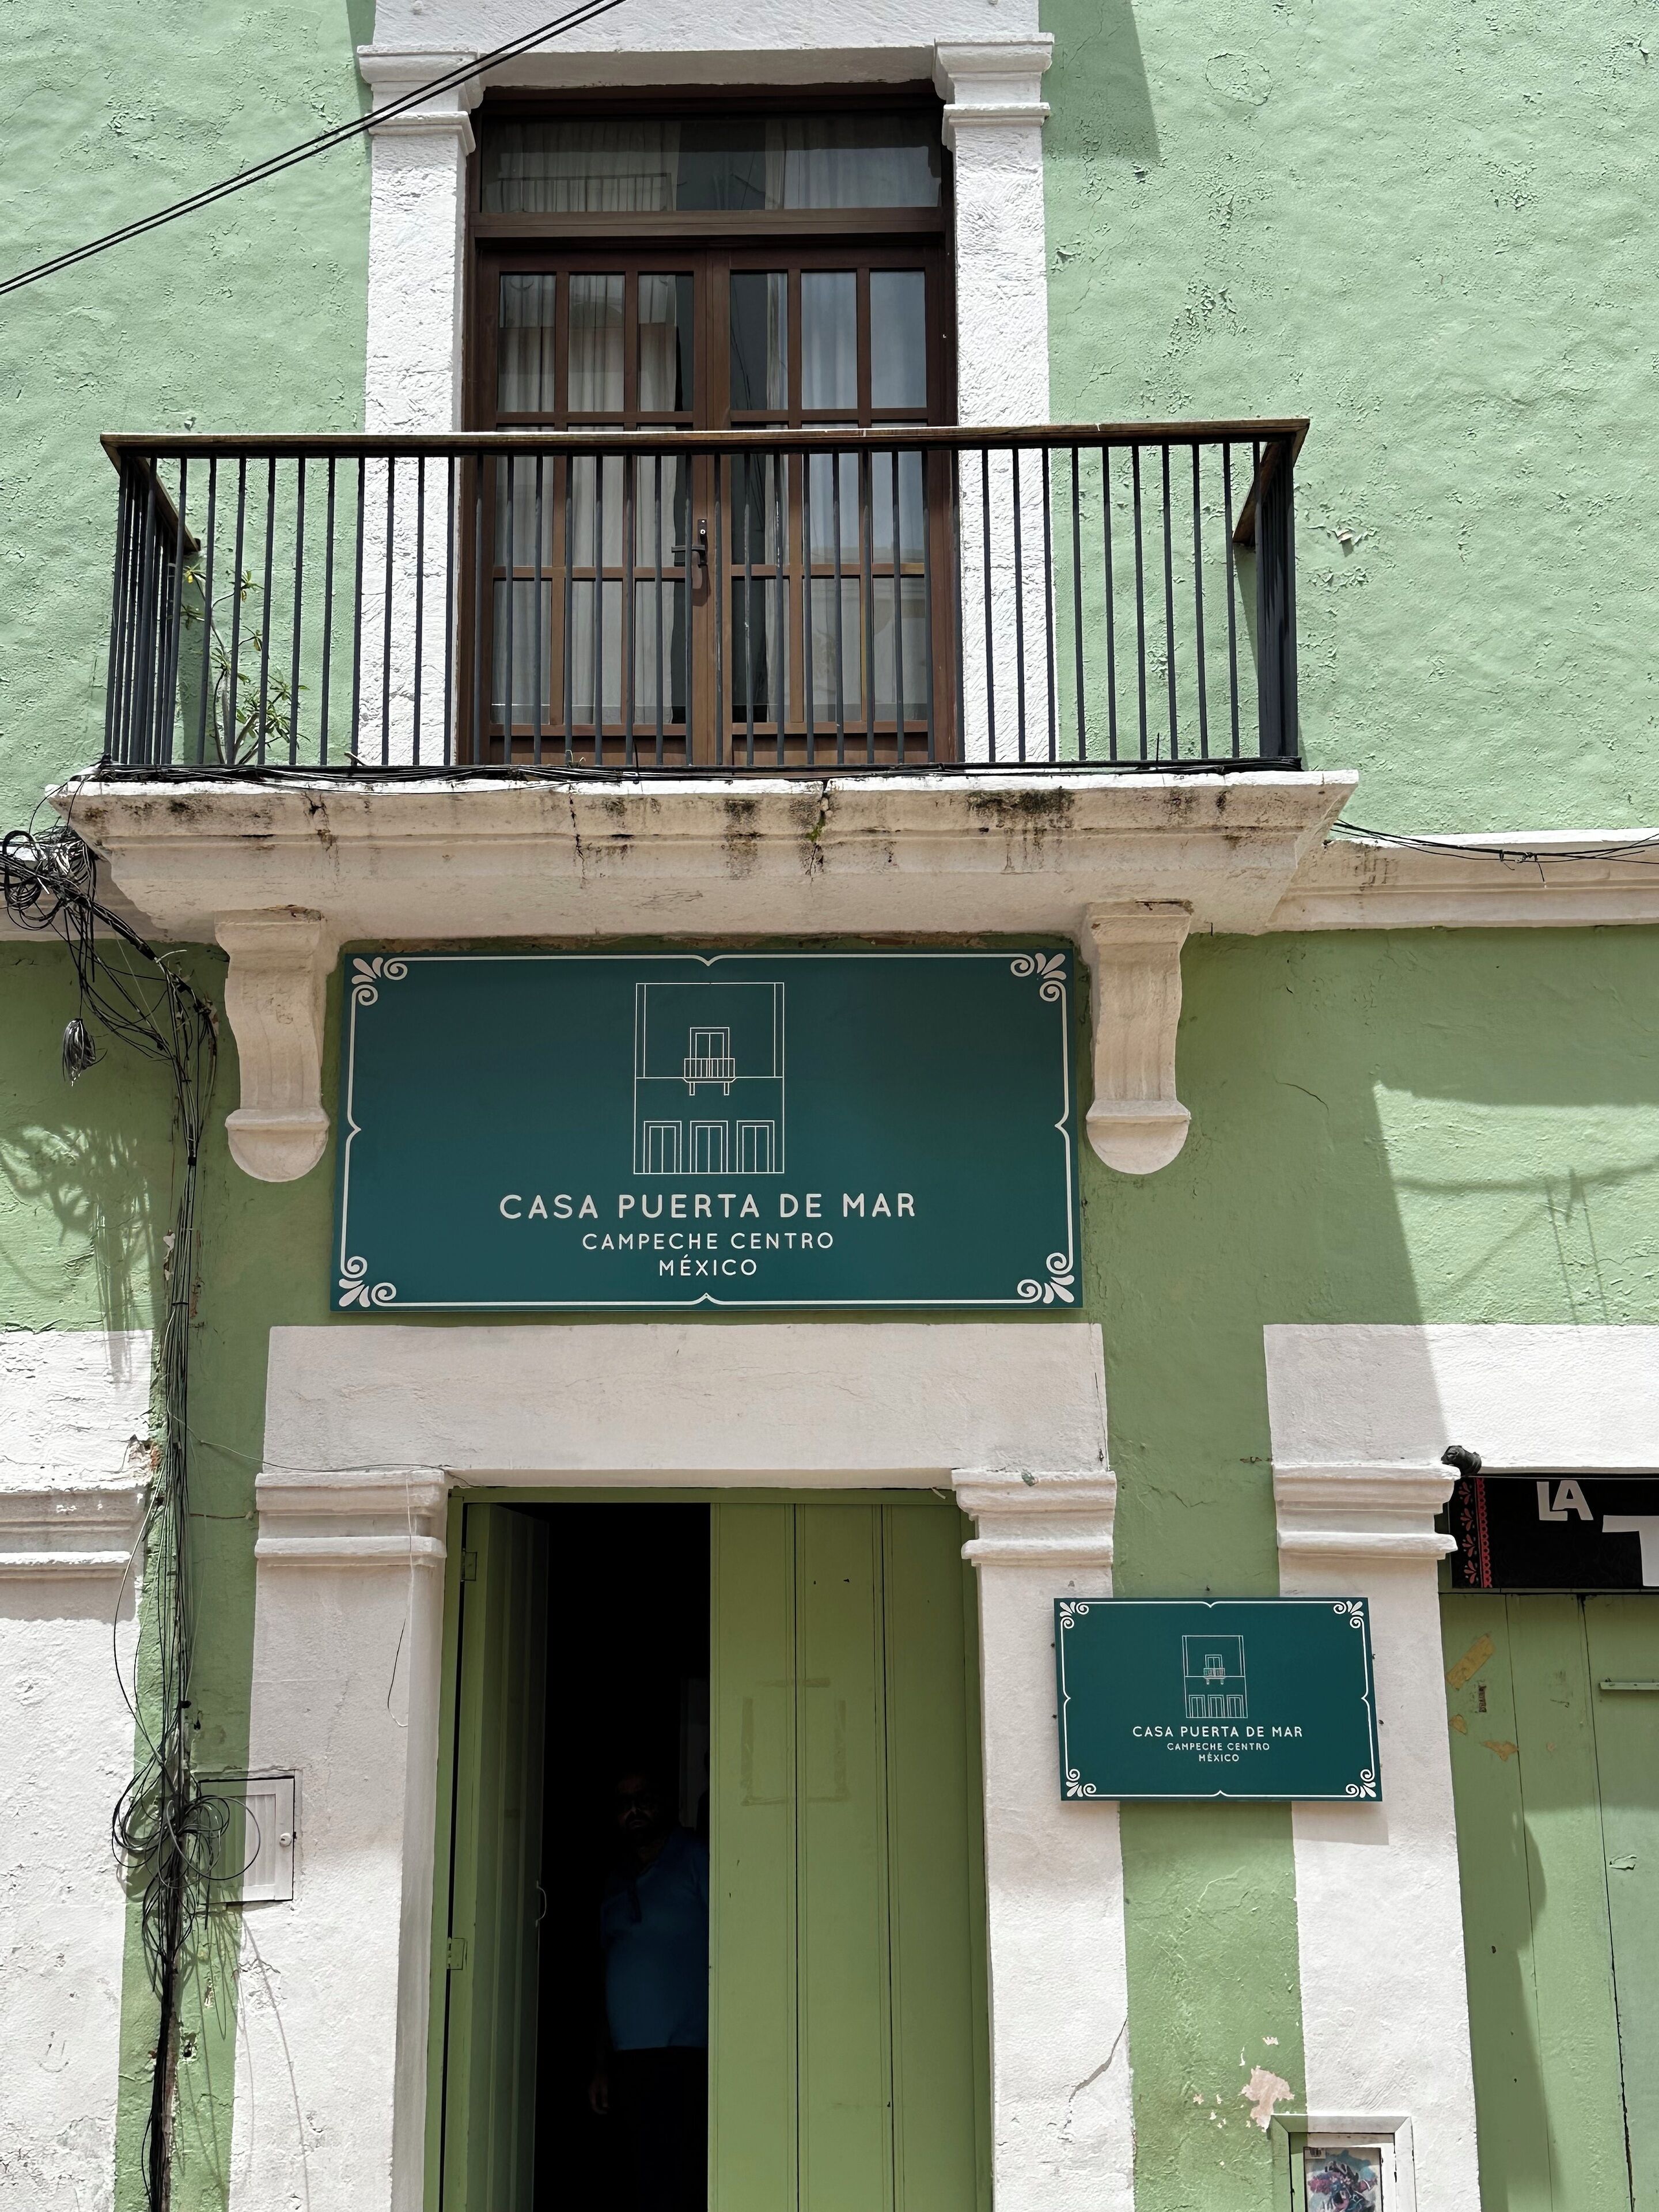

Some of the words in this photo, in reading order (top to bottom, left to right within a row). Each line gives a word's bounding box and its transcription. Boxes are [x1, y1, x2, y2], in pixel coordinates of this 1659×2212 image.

[499, 1194, 599, 1219] CASA
[619, 1194, 760, 1219] PUERTA
[780, 1193, 822, 1218] DE
[842, 1192, 915, 1218] MAR
[582, 1233, 718, 1250] CAMPECHE
[730, 1232, 834, 1249] CENTRO
[659, 1253, 757, 1277] MÉXICO
[1536, 1480, 1594, 1521] LA
[1132, 1726, 1174, 1737] CASA
[1180, 1726, 1239, 1737] PUERTA
[1246, 1726, 1264, 1737] DE
[1272, 1726, 1302, 1737] MAR
[1166, 1743, 1223, 1751] CAMPECHE
[1226, 1743, 1270, 1751] CENTRO
[1198, 1752, 1240, 1762] MÉXICO
